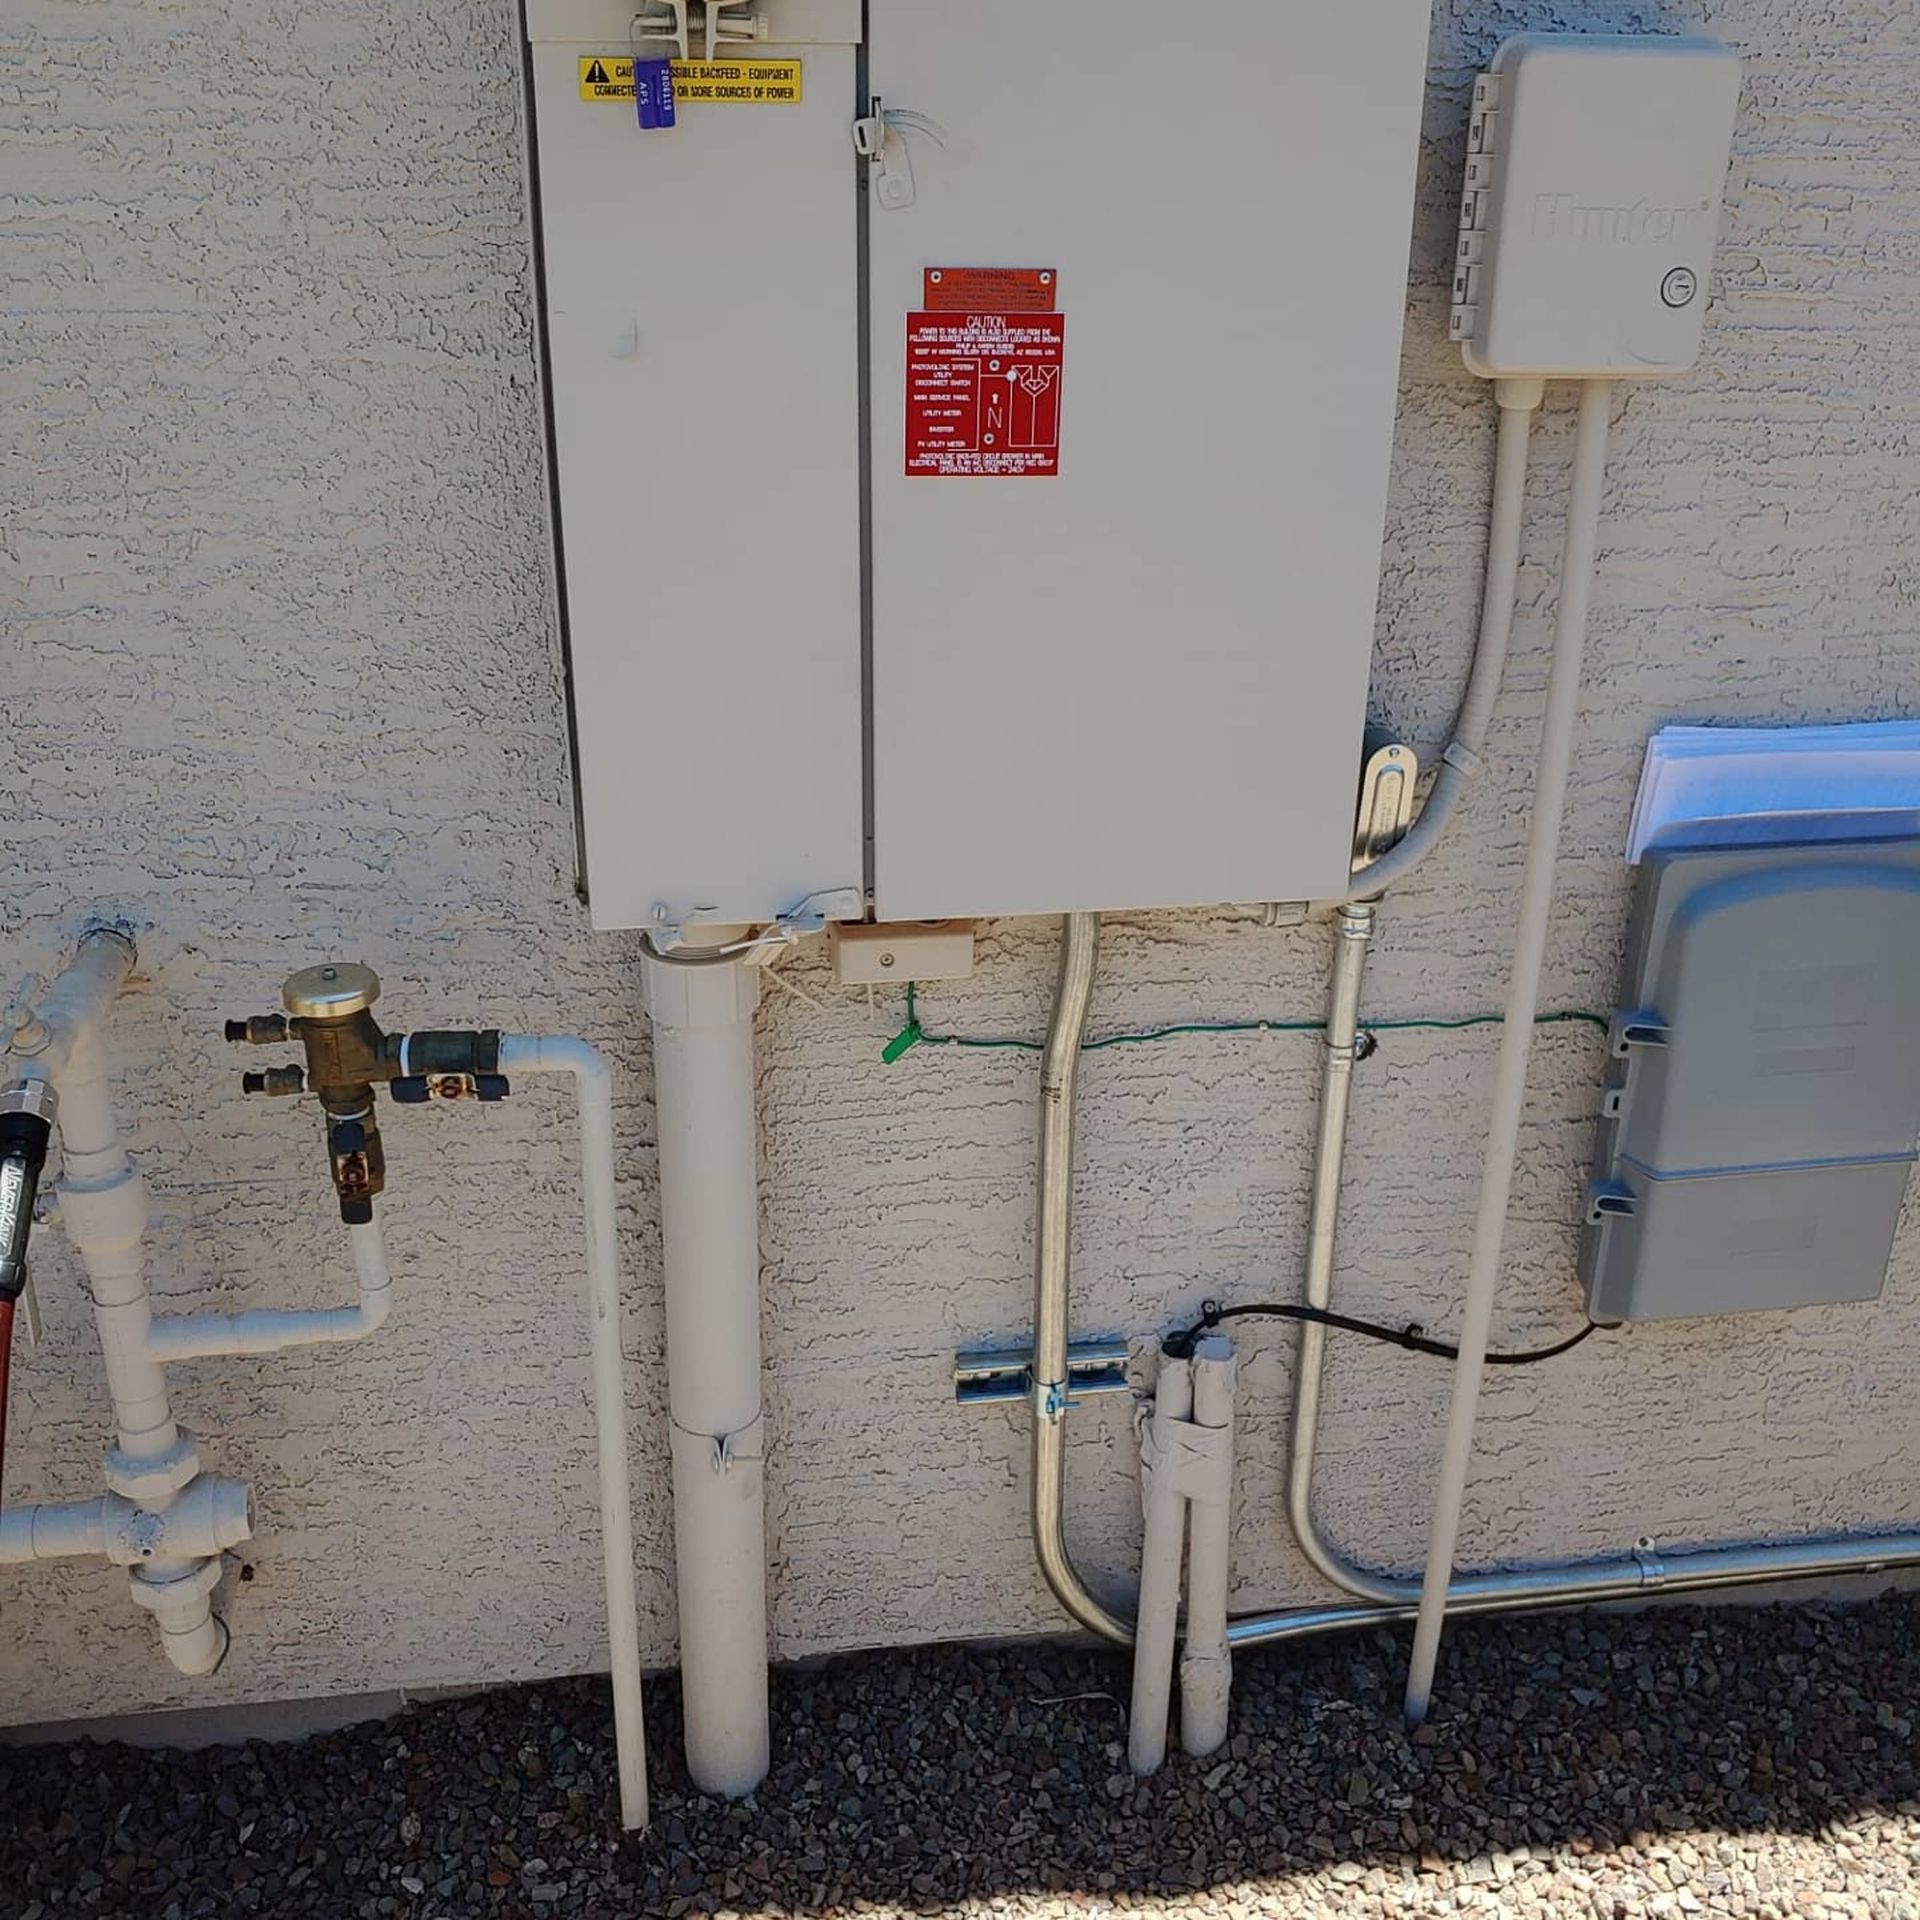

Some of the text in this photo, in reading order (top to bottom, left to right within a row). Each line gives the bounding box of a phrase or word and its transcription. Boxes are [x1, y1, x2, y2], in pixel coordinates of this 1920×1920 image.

[700, 67, 740, 79] BACKFEED
[748, 68, 793, 80] EQUIPMENT
[594, 85, 636, 97] CONNECTE
[677, 85, 689, 97] OR
[691, 86, 713, 97] MORE
[715, 87, 751, 98] SOURCES
[753, 87, 764, 98] OF
[766, 87, 794, 99] POWER
[639, 82, 649, 105] APS
[966, 315, 1006, 328] CAUTION
[988, 407, 1002, 428] N
